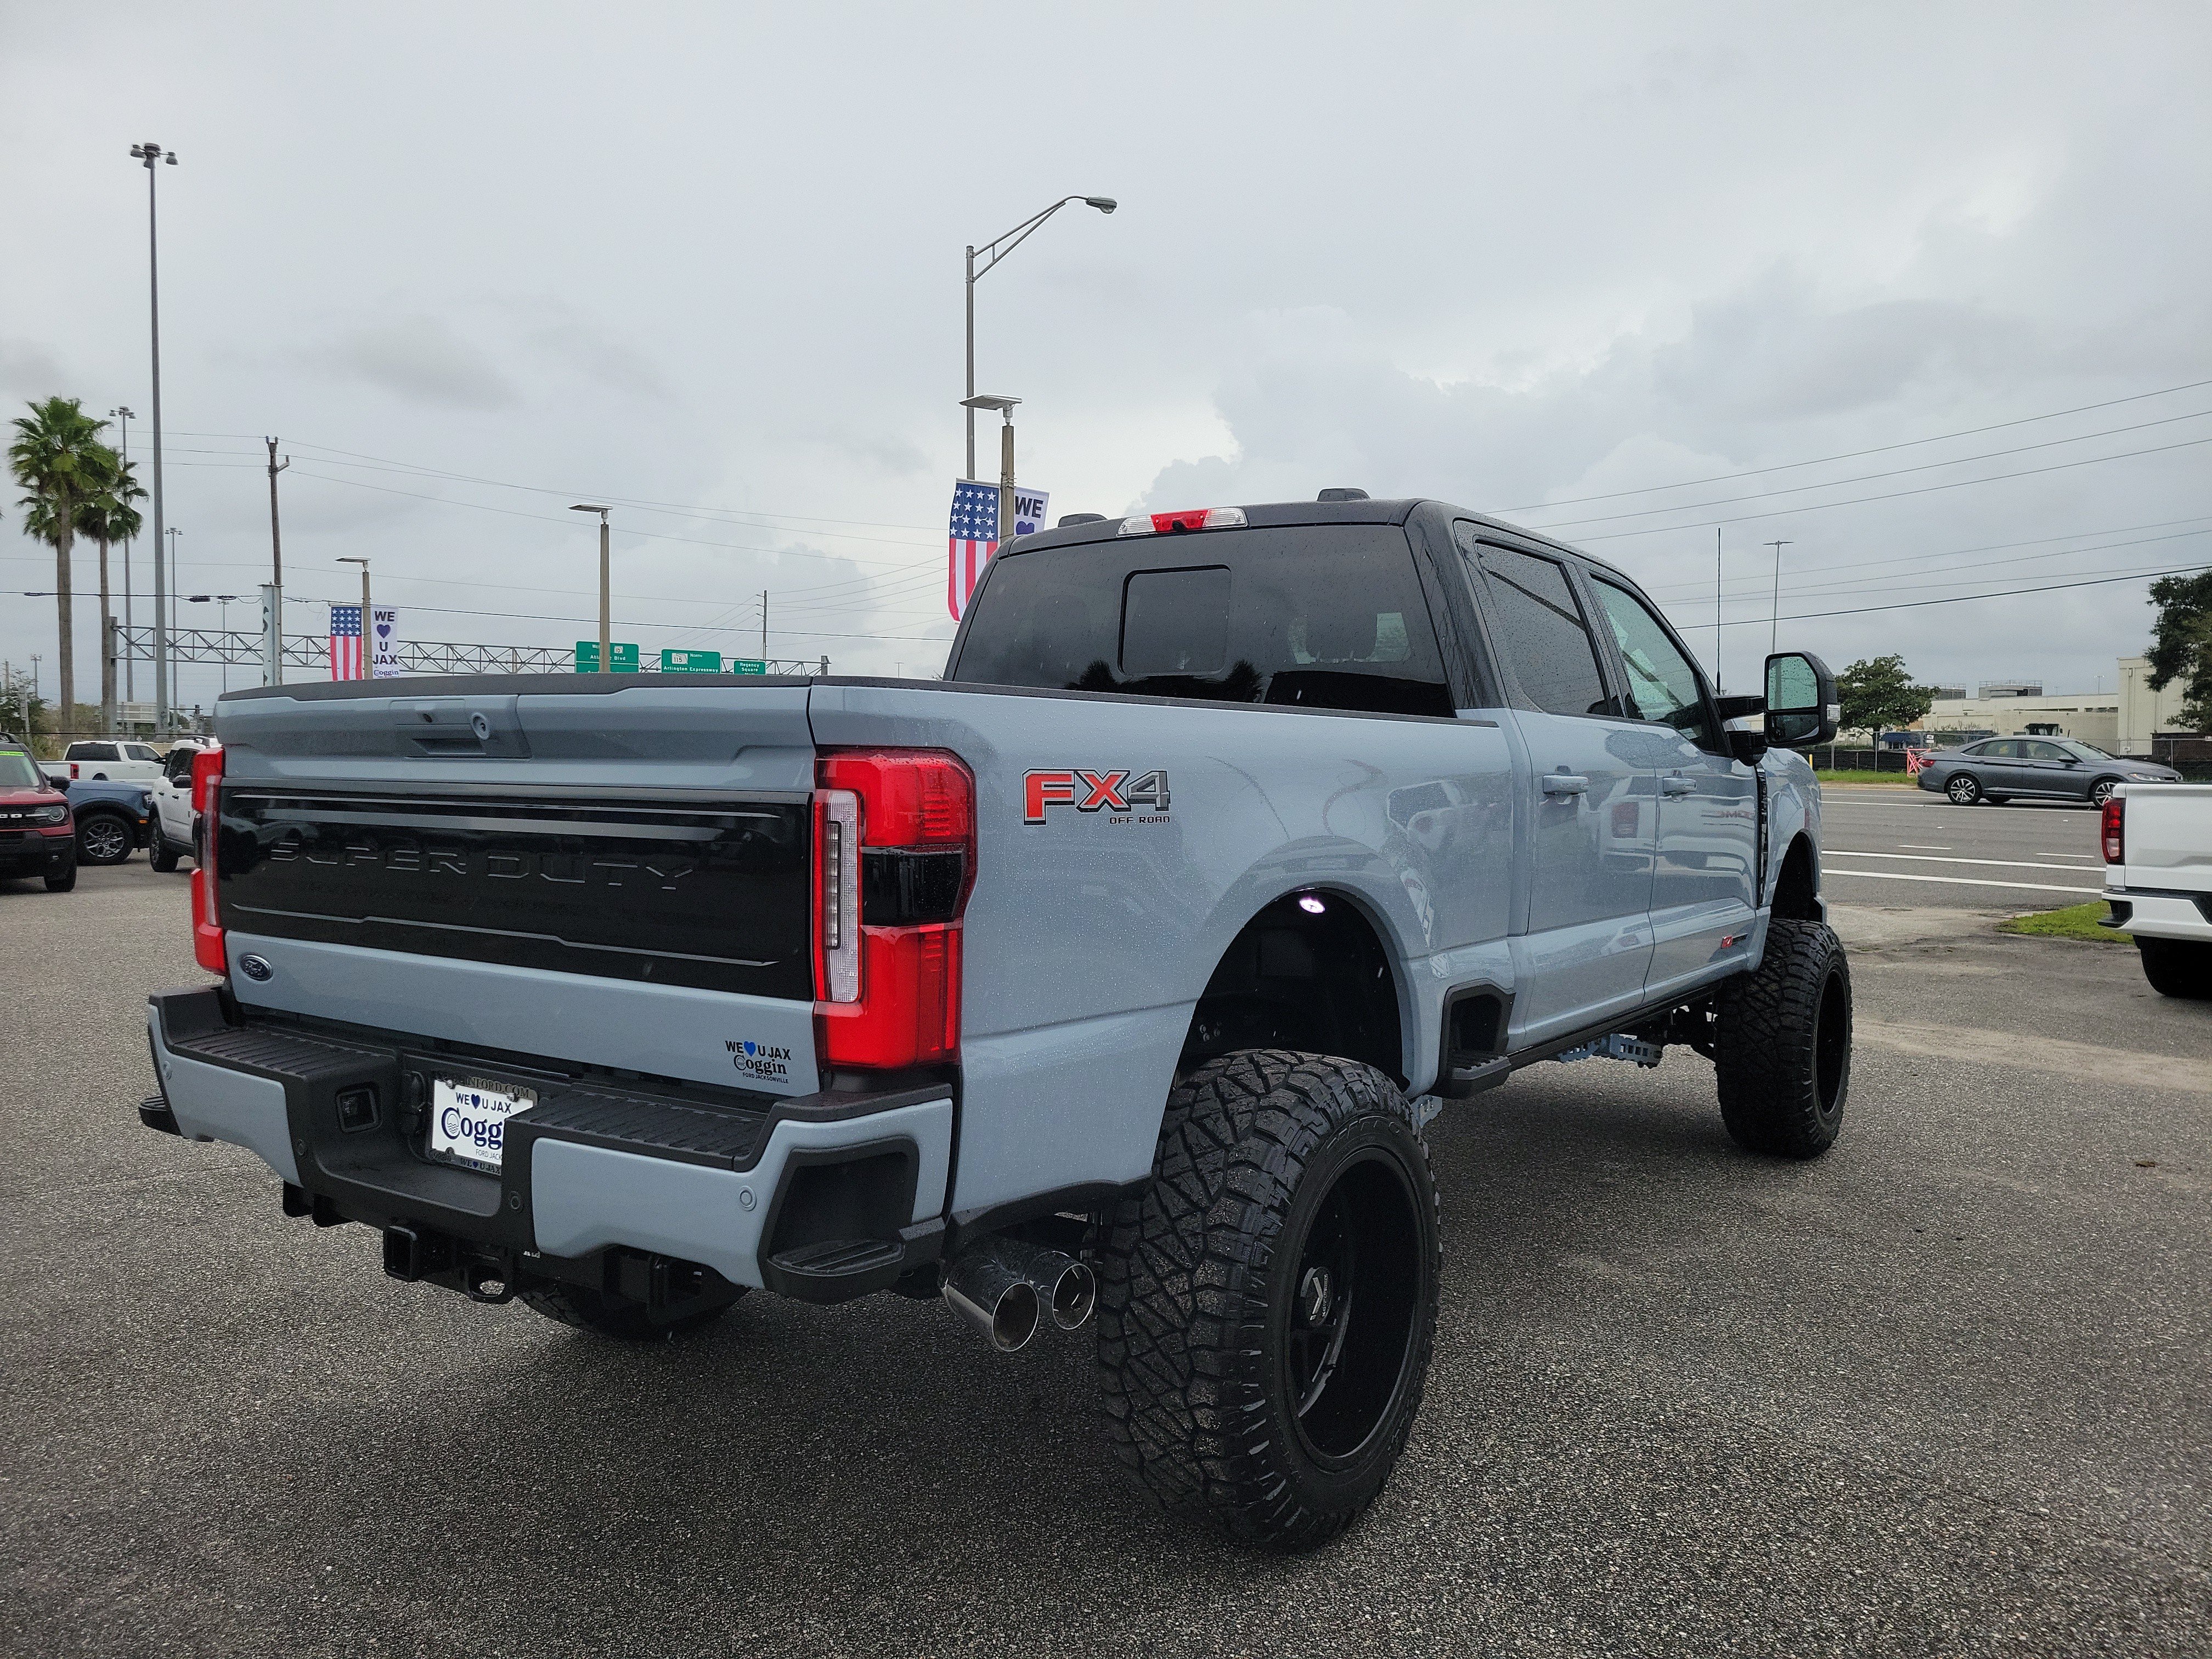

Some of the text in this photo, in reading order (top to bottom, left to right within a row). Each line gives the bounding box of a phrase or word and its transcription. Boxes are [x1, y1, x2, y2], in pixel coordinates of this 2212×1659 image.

[1015, 495, 1043, 518] WE
[375, 611, 395, 622] WE
[379, 641, 388, 652] U
[373, 654, 398, 665] JAX
[1022, 768, 1171, 825] FX4
[270, 842, 693, 890] SUPER DUTY
[725, 1040, 791, 1060] WE U JAX
[733, 1054, 787, 1076] Coggin
[755, 1074, 789, 1084] JACKSONVILLE
[456, 1092, 512, 1114] WE U JAX
[441, 1107, 503, 1150] Cogg
[476, 1149, 489, 1158] FORD
